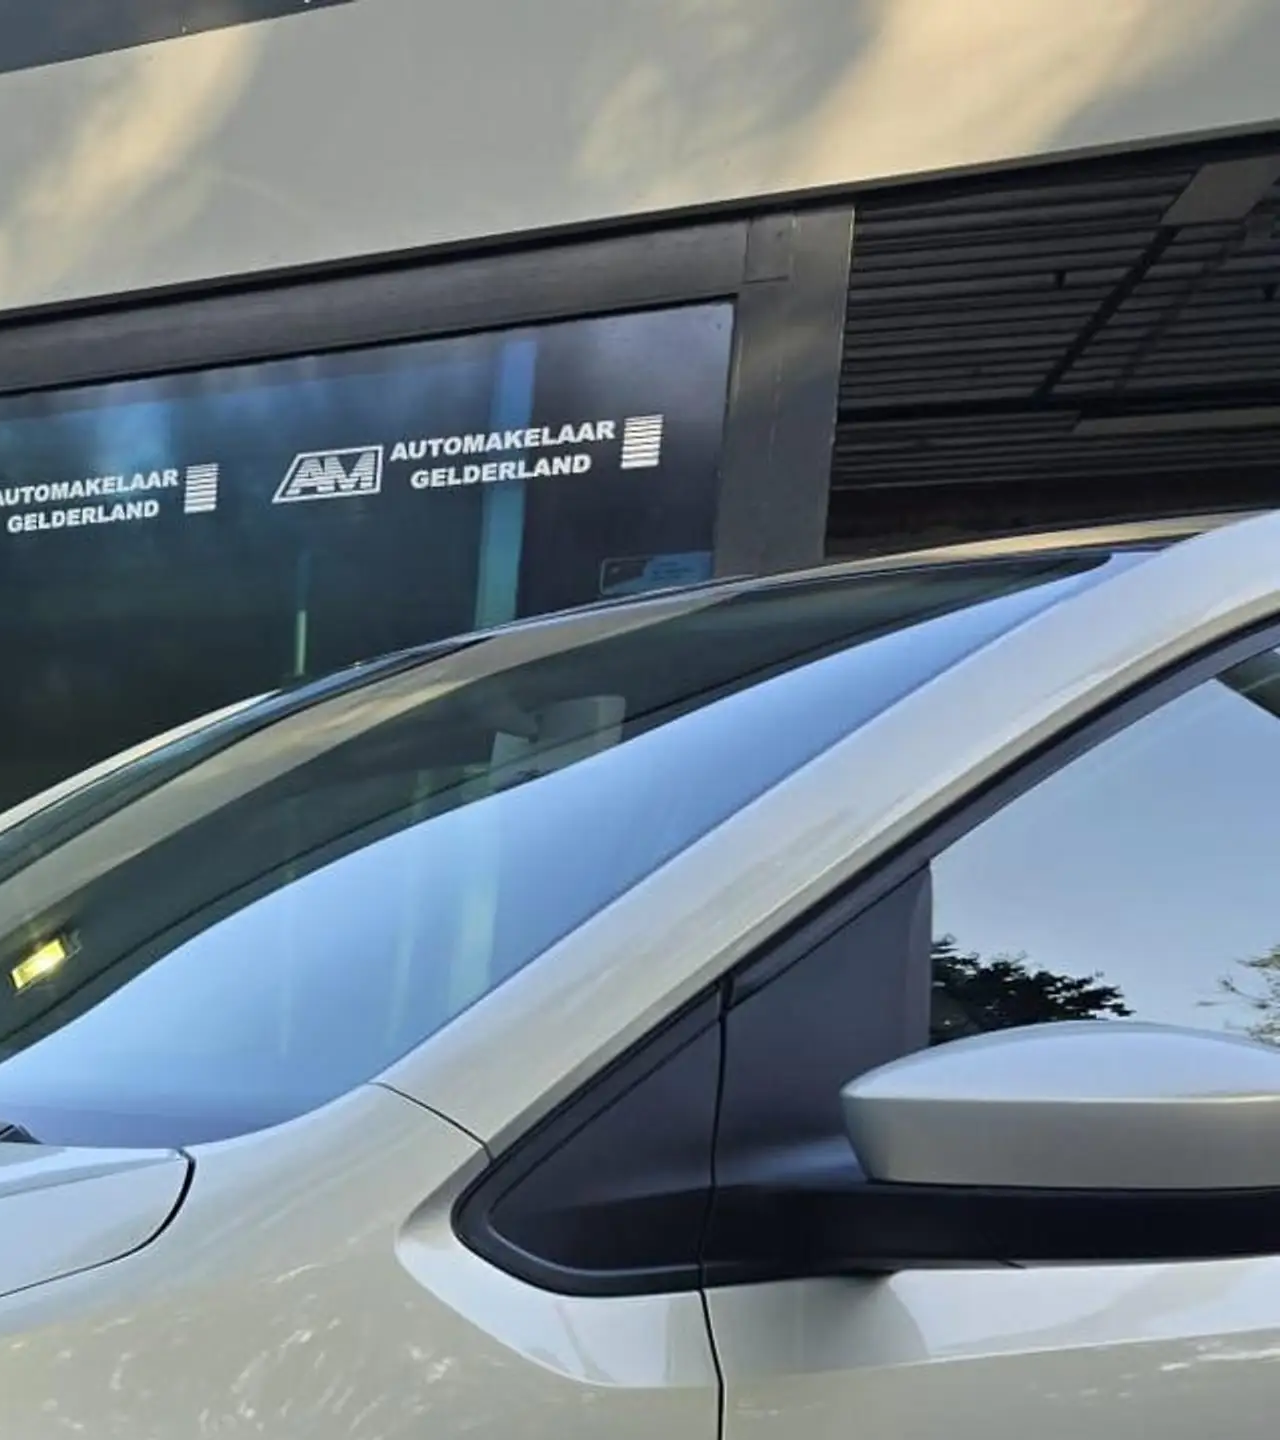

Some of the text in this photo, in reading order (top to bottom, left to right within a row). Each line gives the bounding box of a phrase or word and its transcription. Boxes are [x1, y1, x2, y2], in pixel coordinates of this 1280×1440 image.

[390, 420, 616, 462] AUTOMAKELAAR
[286, 452, 375, 494] AM
[411, 455, 591, 490] GELDERLAND
[7, 500, 159, 533] GELDERLAND
